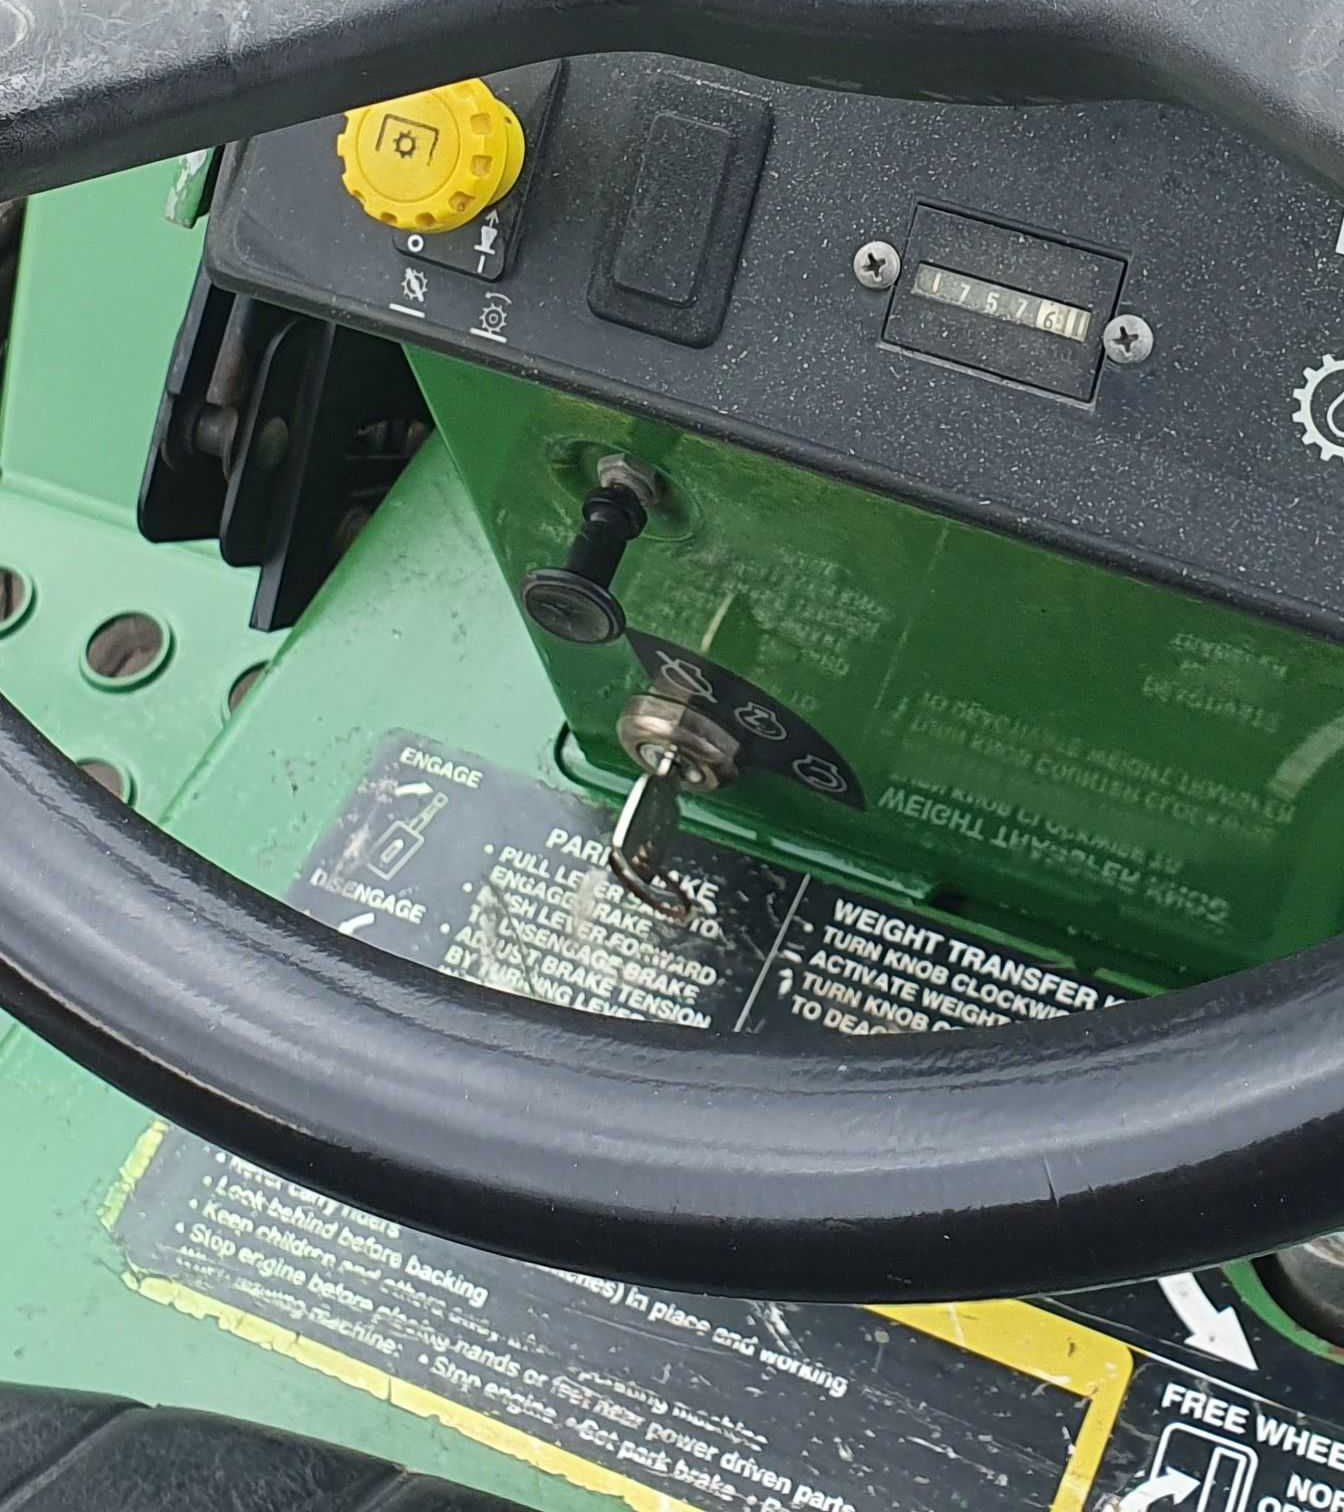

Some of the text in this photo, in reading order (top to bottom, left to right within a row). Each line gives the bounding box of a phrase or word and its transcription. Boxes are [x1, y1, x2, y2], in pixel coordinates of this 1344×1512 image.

[399, 746, 483, 789] ENGAGE
[499, 845, 552, 879] PULL
[309, 867, 428, 925] DISENGAGE
[444, 944, 477, 970] BY
[623, 962, 700, 1005] BRAKE
[808, 949, 921, 1002] ACTIVATE
[823, 925, 1071, 1020] TURN KNOB CLOCKWI
[833, 898, 1099, 1011] WEIGHT TRANSFER
[541, 955, 616, 993] BRAKE
[616, 984, 712, 1029] TENSION
[790, 994, 823, 1022] TO
[801, 971, 931, 1032] TURN KNOB
[267, 1197, 340, 1238] behind
[337, 1226, 403, 1268] before
[405, 1254, 489, 1309] backing
[647, 1300, 711, 1339] place
[759, 1346, 849, 1398] working
[523, 1365, 550, 1387] or
[644, 1420, 719, 1462] power
[719, 1450, 792, 1495] driven
[1160, 1382, 1250, 1435] FREE
